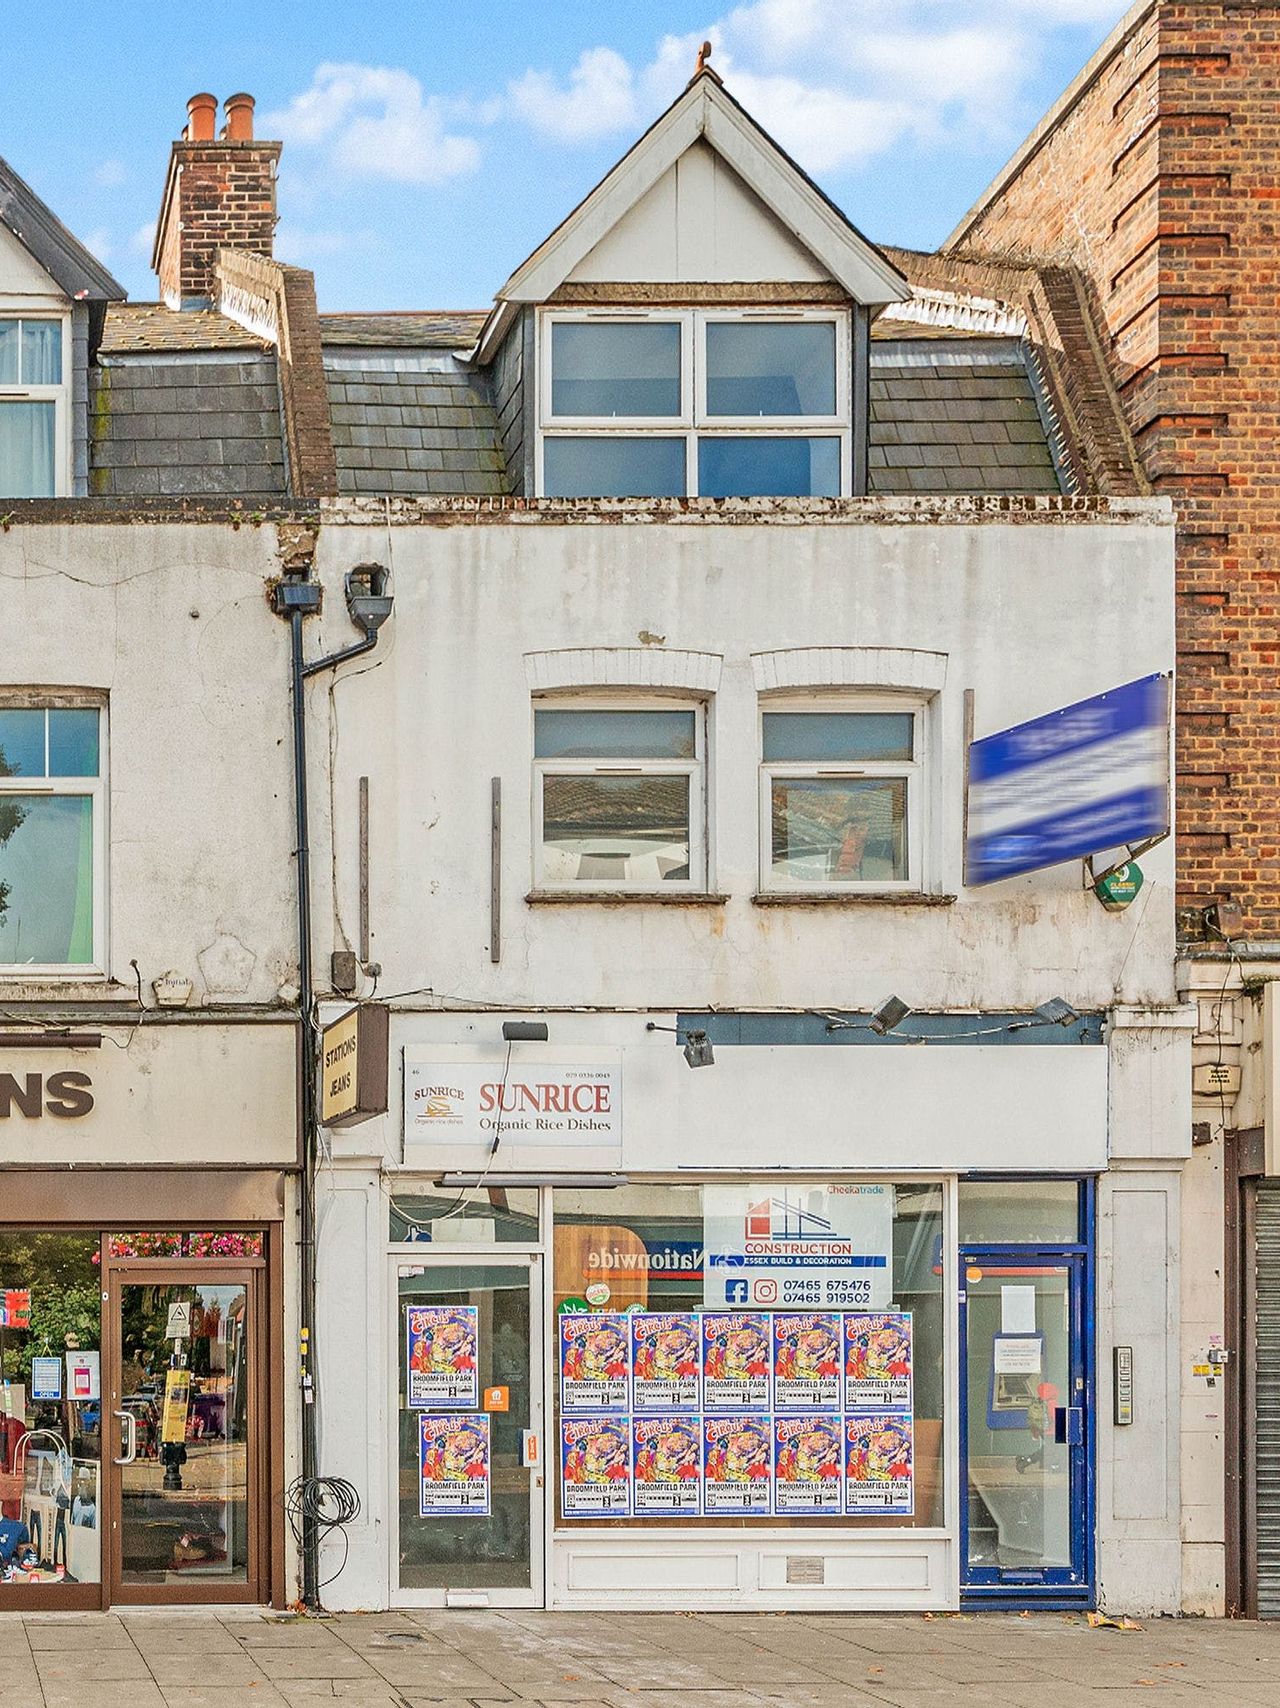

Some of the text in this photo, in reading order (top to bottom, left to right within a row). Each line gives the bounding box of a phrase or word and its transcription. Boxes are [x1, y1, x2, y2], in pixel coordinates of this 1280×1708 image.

[326, 1035, 356, 1068] STATIONS
[330, 1072, 351, 1098] JEANS
[414, 1086, 464, 1101] SUNRICE
[480, 1083, 611, 1113] SUNRICE
[480, 1118, 611, 1133] Organic Rice Dishes
[827, 1185, 884, 1194] Checkatrade
[745, 1243, 852, 1254] CONSTRUCTION
[744, 1256, 769, 1265] ESSEX
[771, 1256, 793, 1265] BUILD
[803, 1256, 852, 1265] DECORATION
[783, 1280, 871, 1290] 07465 675476
[783, 1293, 871, 1303] 07465 919502
[749, 1380, 766, 1388] PARK
[819, 1380, 837, 1388] PARK
[890, 1380, 908, 1388] PARK
[468, 1482, 485, 1490] PARK
